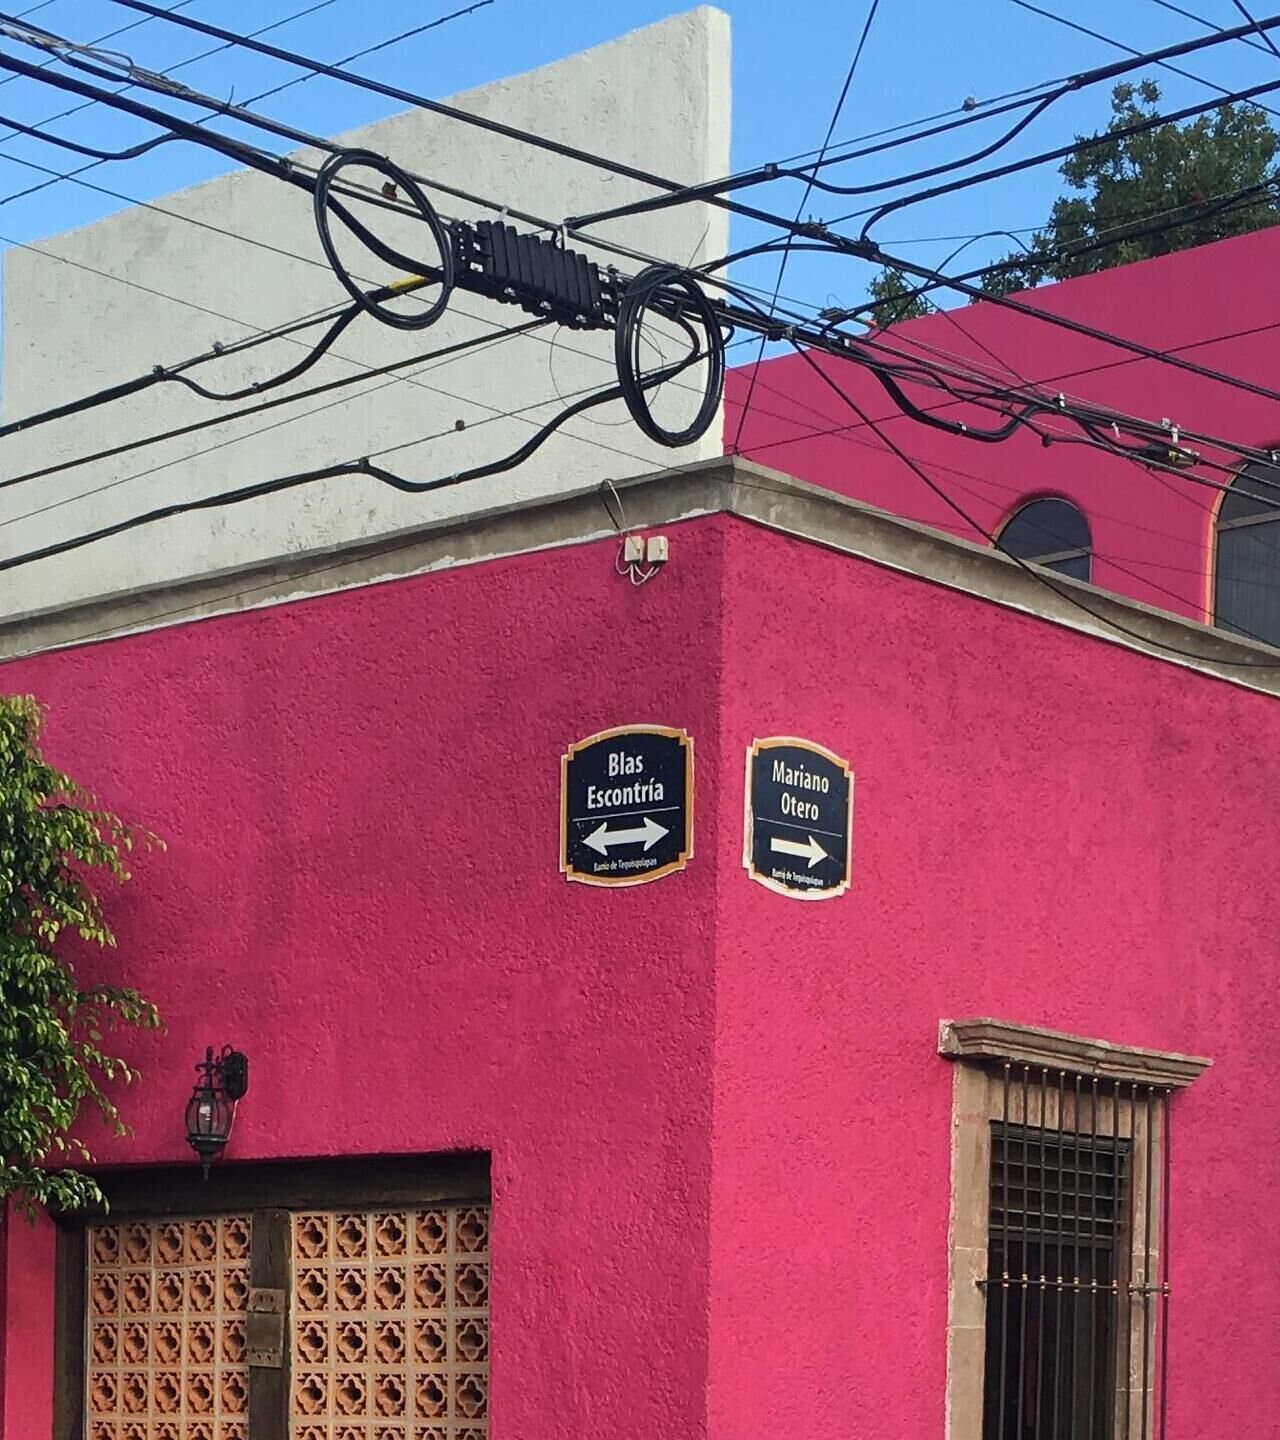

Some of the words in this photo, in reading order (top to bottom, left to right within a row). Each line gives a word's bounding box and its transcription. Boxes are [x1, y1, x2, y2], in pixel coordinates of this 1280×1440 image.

[608, 751, 643, 777] Blas
[772, 759, 830, 795] Mariano
[587, 777, 664, 809] Escontría
[781, 794, 819, 821] Otero
